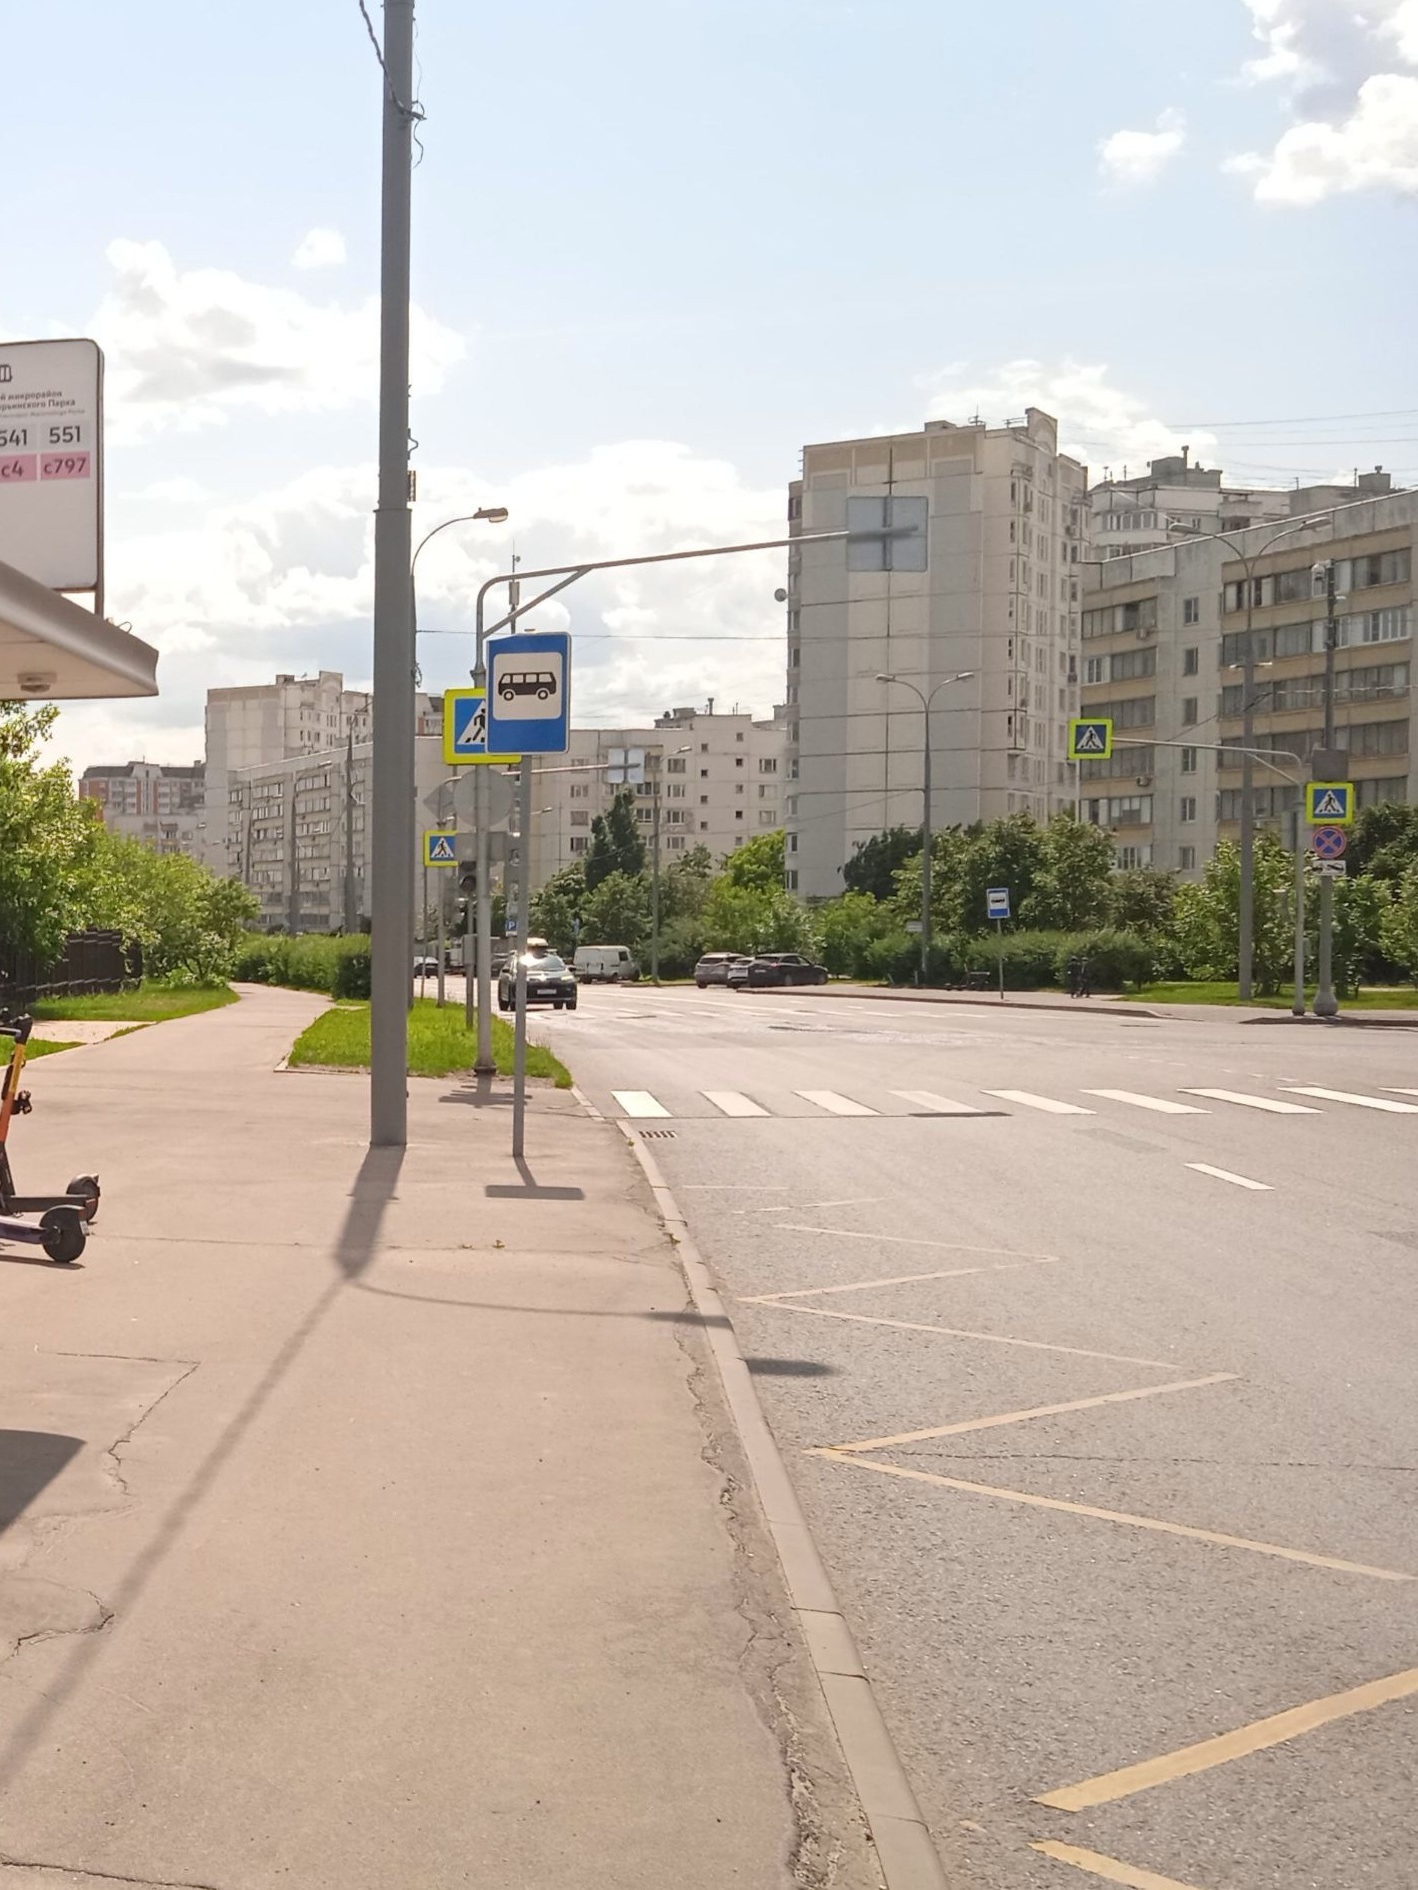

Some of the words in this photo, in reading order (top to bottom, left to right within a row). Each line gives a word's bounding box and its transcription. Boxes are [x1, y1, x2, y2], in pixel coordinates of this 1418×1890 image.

[9, 391, 62, 400] микрорайон
[49, 400, 75, 408] Парка
[49, 426, 81, 444] 551
